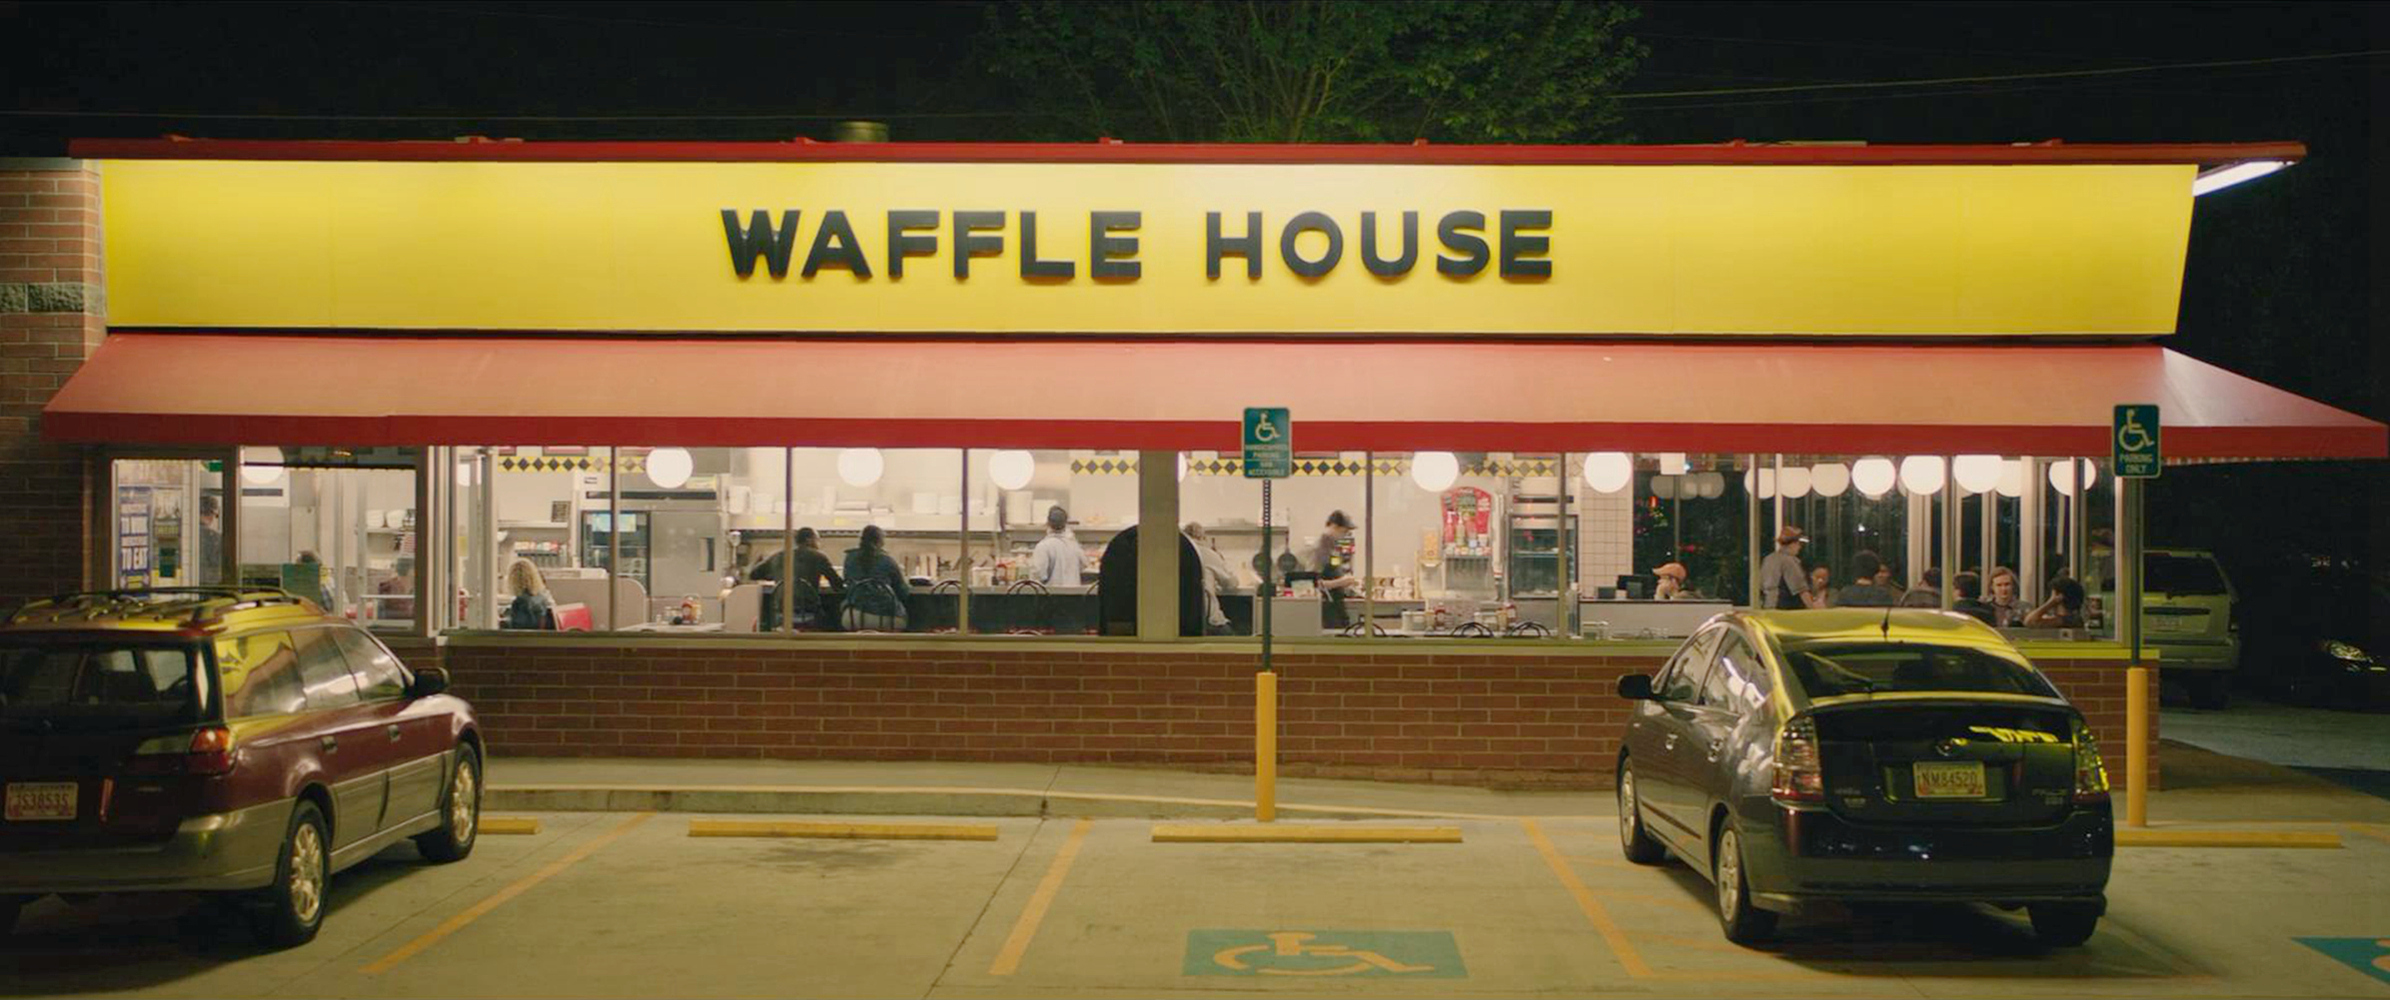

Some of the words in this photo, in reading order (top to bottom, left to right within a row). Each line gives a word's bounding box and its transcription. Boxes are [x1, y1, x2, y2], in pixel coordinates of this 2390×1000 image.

[720, 209, 1142, 281] WAFFLE
[1205, 209, 1554, 281] HOUSE
[2126, 464, 2147, 474] ONLY
